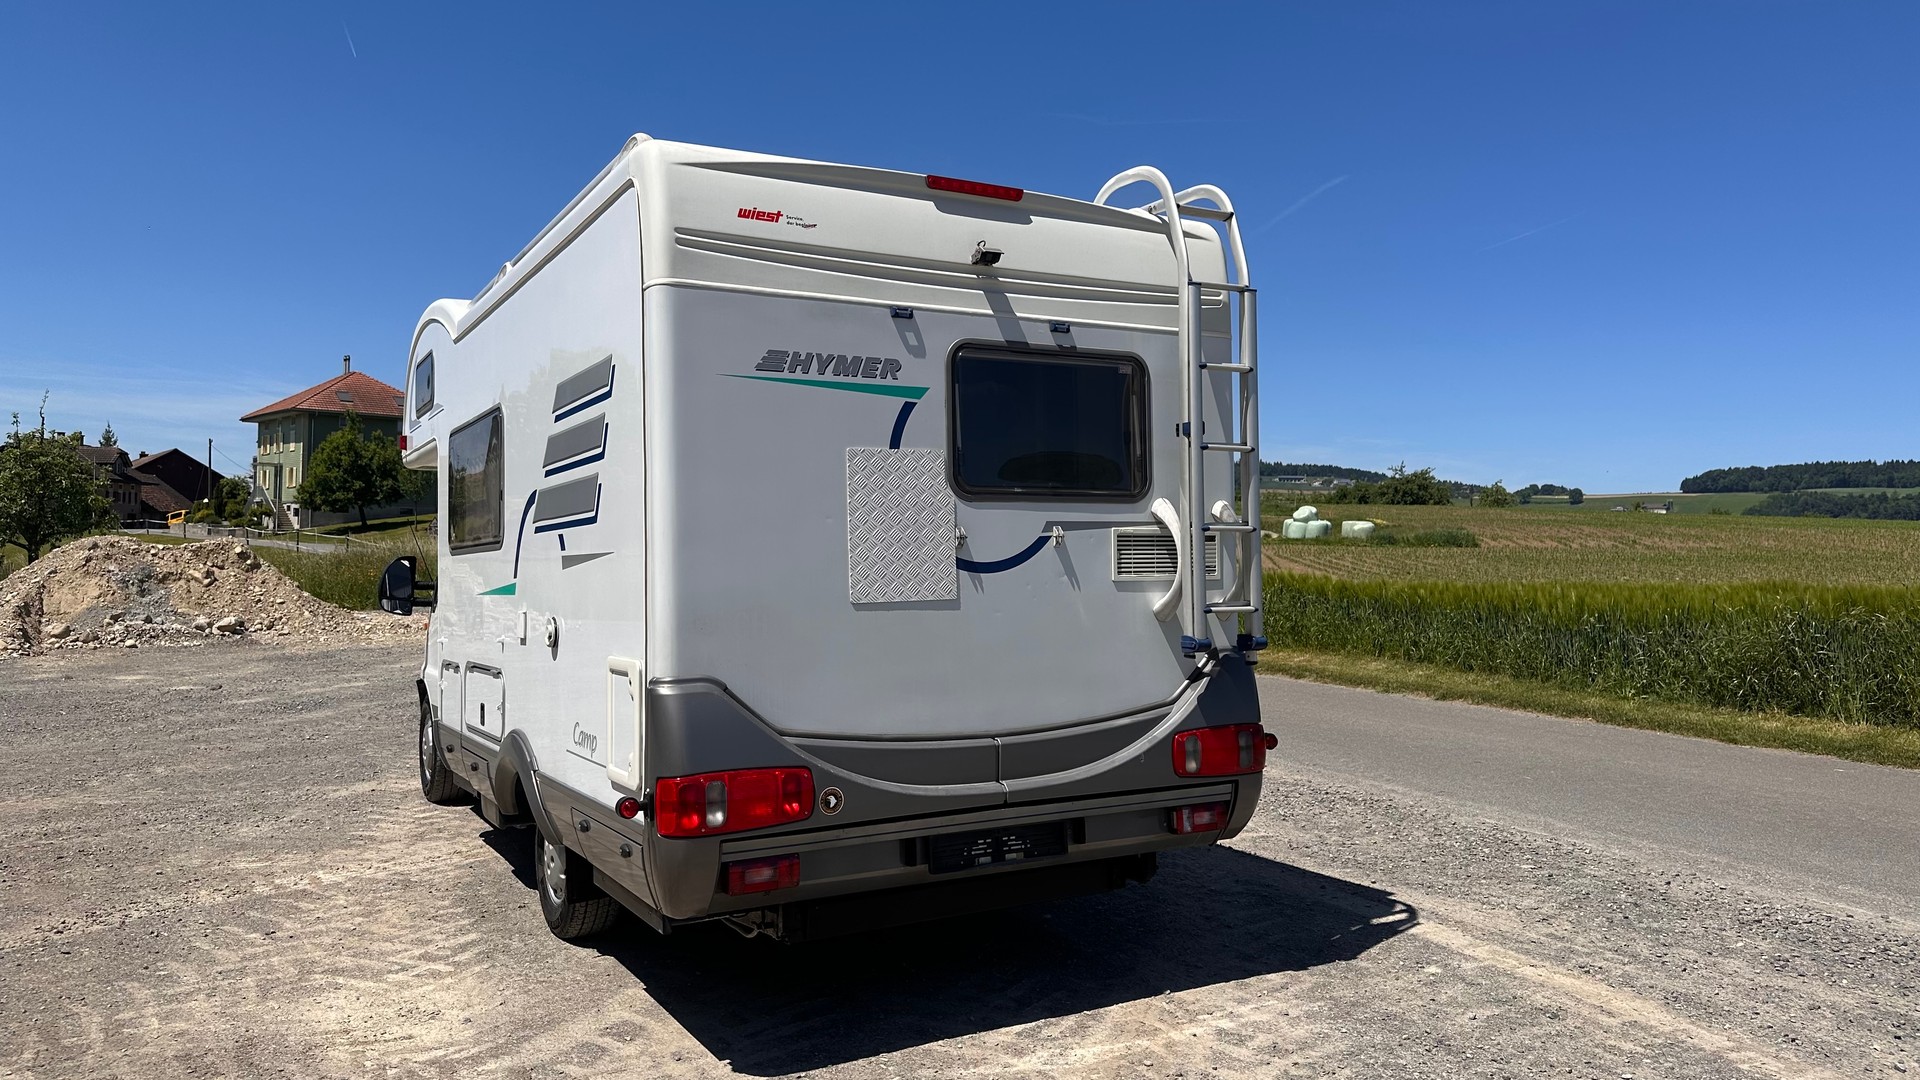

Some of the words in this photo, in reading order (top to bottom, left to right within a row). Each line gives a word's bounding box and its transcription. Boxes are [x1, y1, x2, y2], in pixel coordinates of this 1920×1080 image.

[737, 207, 783, 223] wiest
[786, 351, 902, 380] HYMER
[573, 721, 598, 759] Camp
